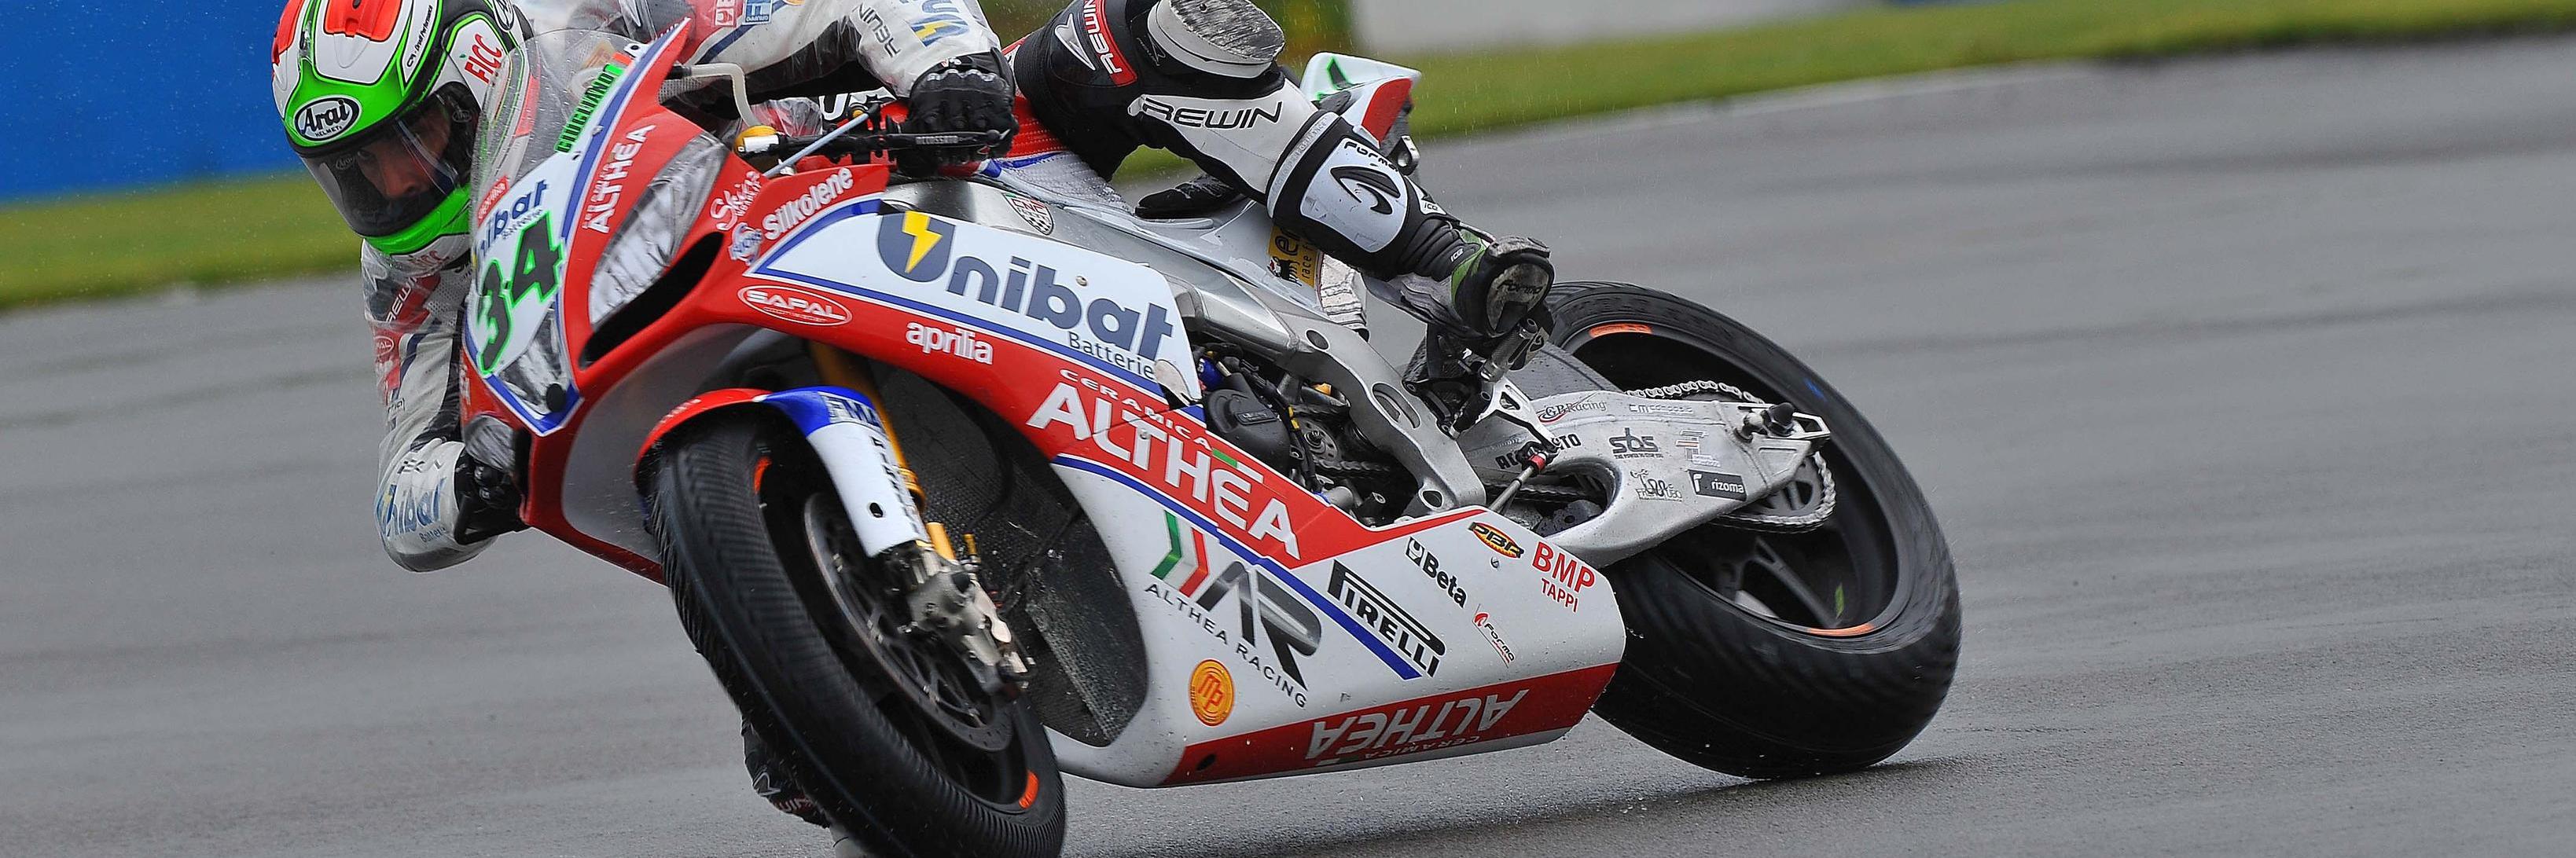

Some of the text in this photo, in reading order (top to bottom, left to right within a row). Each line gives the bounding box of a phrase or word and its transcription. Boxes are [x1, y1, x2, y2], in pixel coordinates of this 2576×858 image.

[852, 4, 901, 57] REWIN
[465, 34, 502, 84] FICC
[300, 99, 350, 134] Arai
[1141, 96, 1283, 129] REWIN
[586, 125, 656, 233] ALTHEA
[478, 211, 564, 373] 34
[877, 210, 1172, 361] Unibat
[1301, 255, 1312, 279] race
[747, 289, 846, 321] SAPAL
[906, 321, 994, 365] aprilia
[1068, 331, 1155, 380] Batterie
[1060, 368, 1213, 452] CERAMICA
[1026, 381, 1302, 560] ALTHEA
[1711, 478, 1745, 493] rizoma
[1421, 553, 1467, 609] Beta
[1532, 541, 1595, 593] BMP
[1327, 559, 1446, 678] PIRELLI
[1541, 578, 1579, 613] TAPPI
[1145, 583, 1307, 708] ALTHEA RACING
[1305, 689, 1529, 761] ALTHEA
[1365, 735, 1480, 759] CERAMICA
